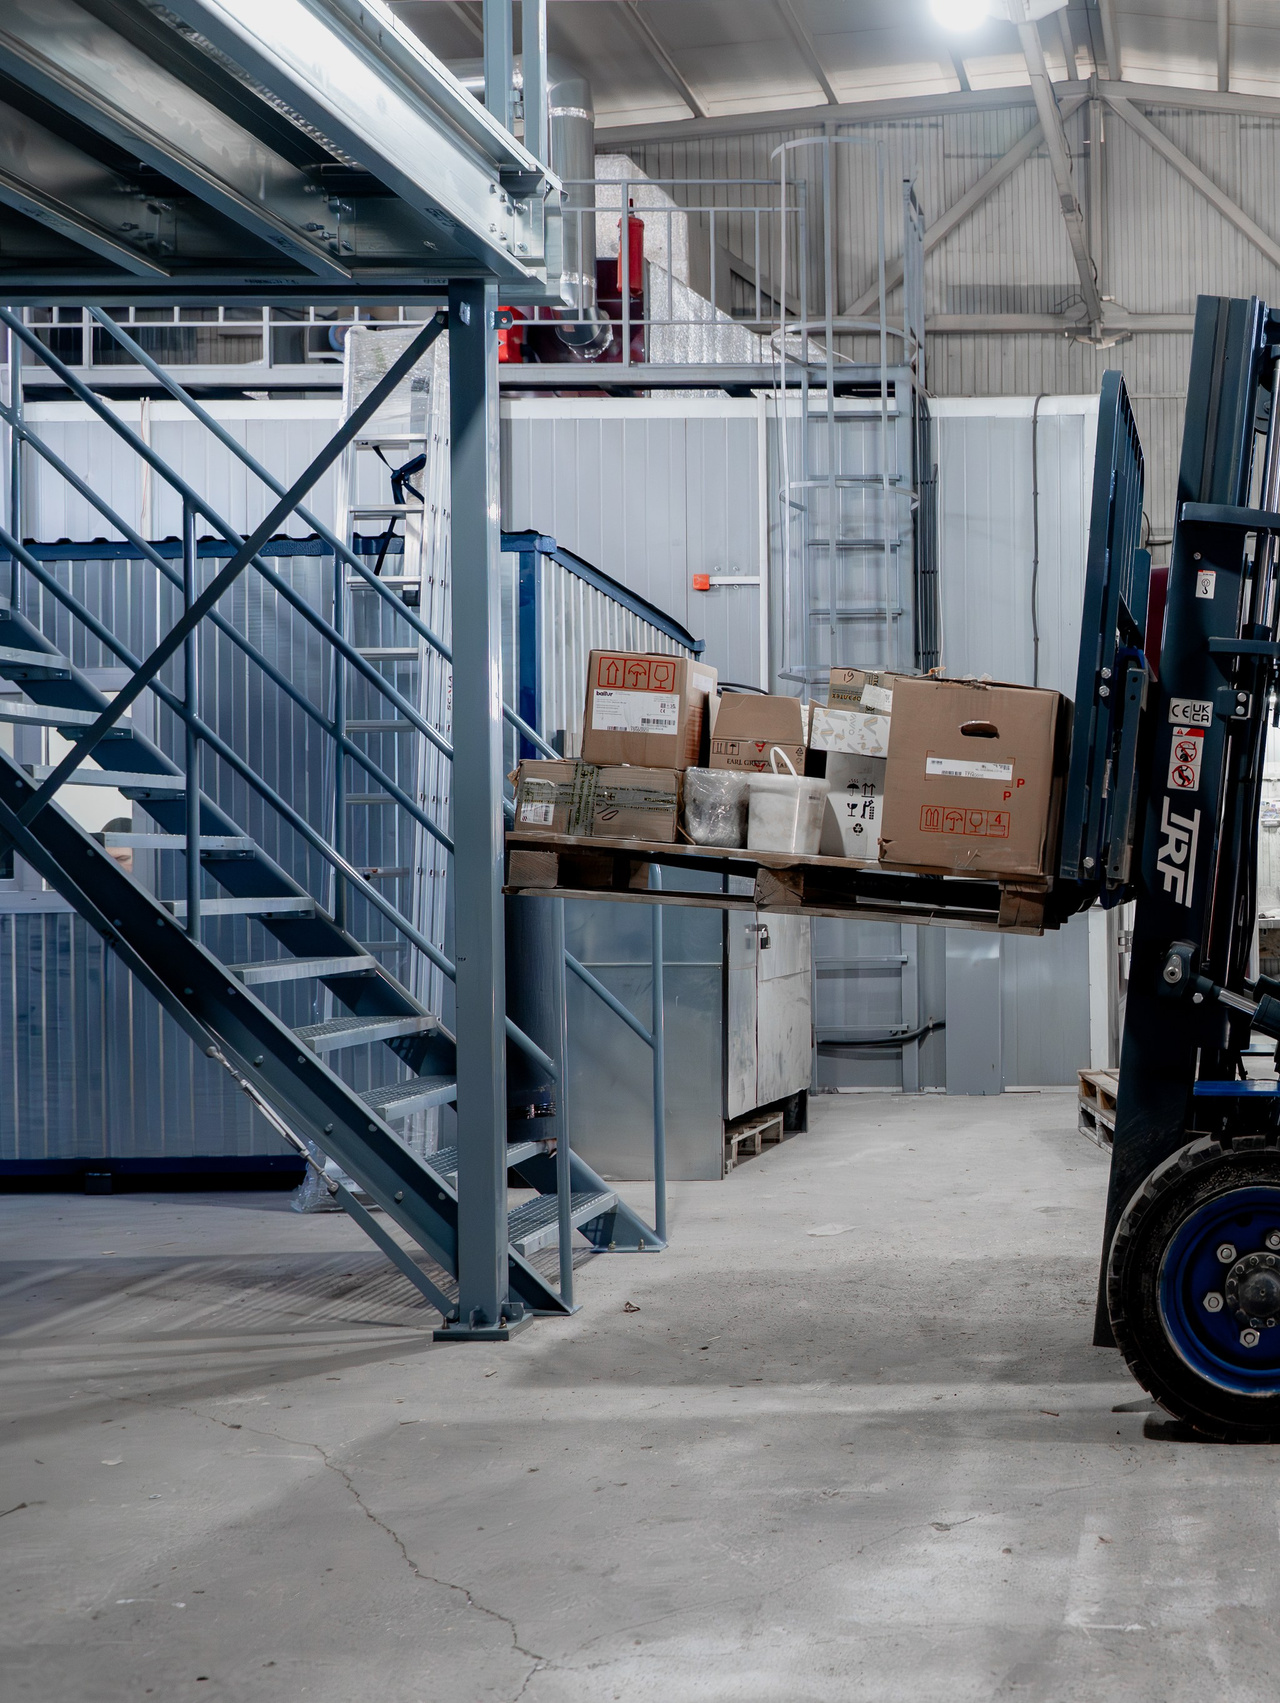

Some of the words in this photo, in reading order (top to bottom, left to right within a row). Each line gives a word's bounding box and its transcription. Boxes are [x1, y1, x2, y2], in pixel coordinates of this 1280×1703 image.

[1171, 704, 1190, 719] CE
[1193, 703, 1210, 714] UK
[1192, 713, 1209, 723] CA
[727, 758, 742, 766] EARL
[1016, 778, 1025, 788] P
[1003, 791, 1011, 801] P
[994, 813, 1002, 825] 4
[1157, 796, 1201, 908] TRF
